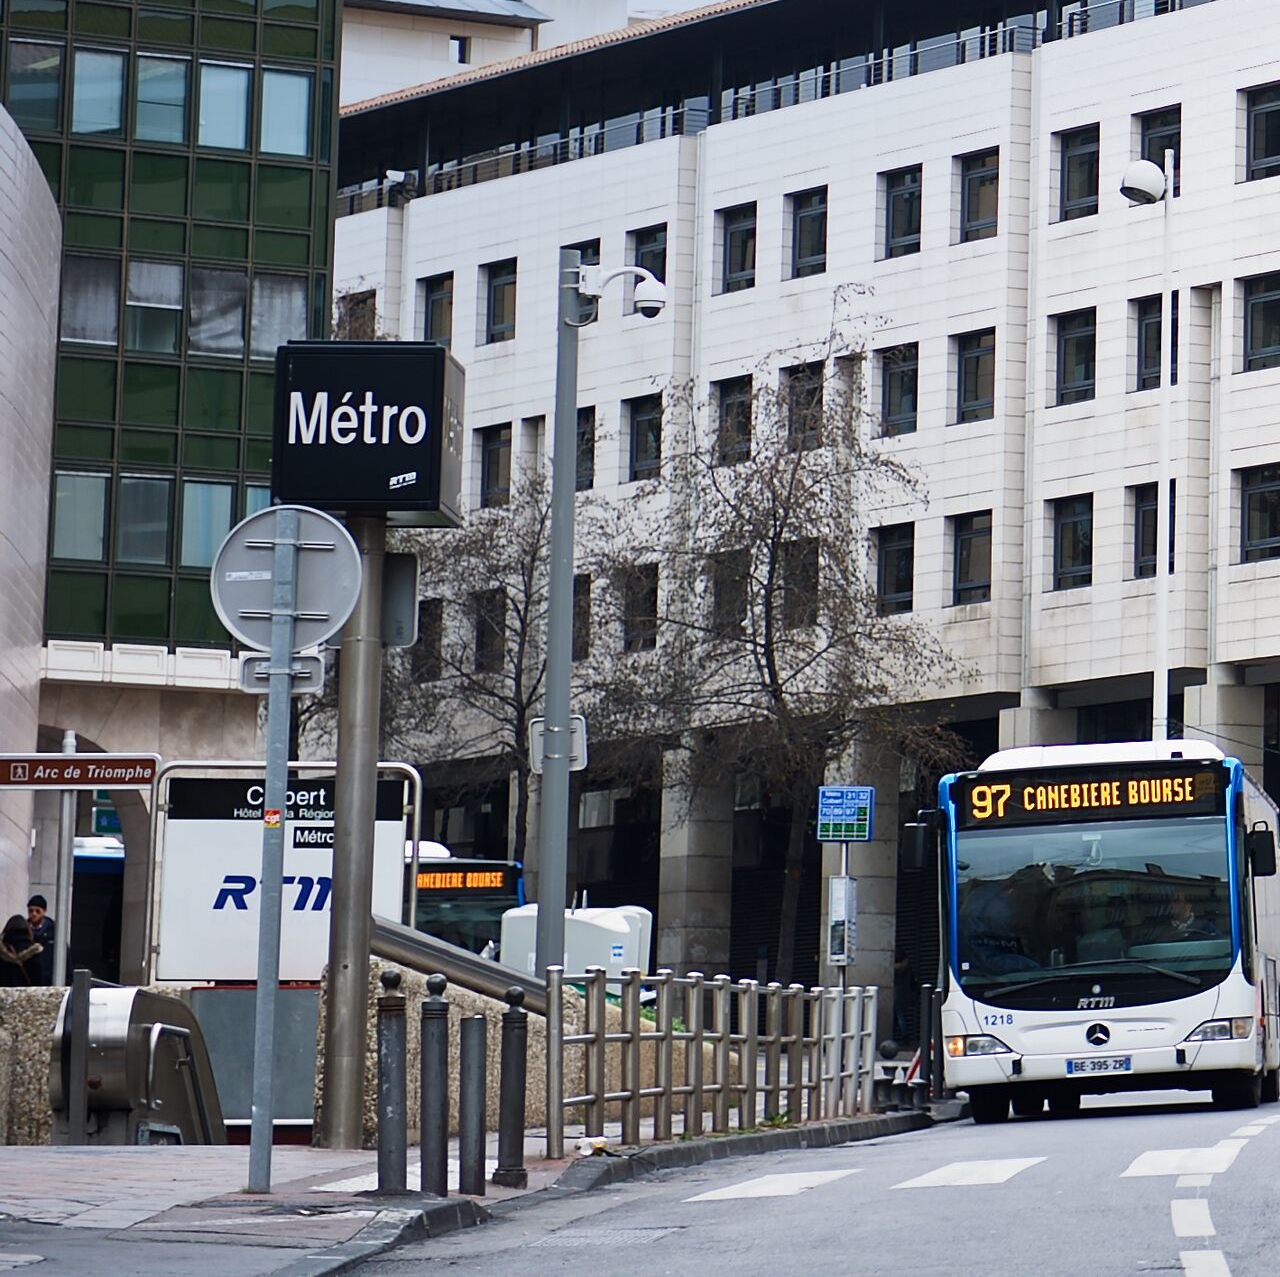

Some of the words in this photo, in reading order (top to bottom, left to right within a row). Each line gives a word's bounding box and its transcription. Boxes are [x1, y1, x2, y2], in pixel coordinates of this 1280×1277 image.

[287, 391, 427, 445] Métro
[34, 765, 59, 778] Arc
[64, 765, 81, 778] de
[87, 765, 152, 781] Triomphe
[971, 784, 1011, 819] 97
[1023, 782, 1121, 811] CANEBIERE
[1128, 777, 1194, 805] BOURSE
[233, 808, 262, 819] Hôtel
[466, 871, 504, 888] BOURSE
[1076, 996, 1116, 1009] RTM
[983, 1014, 1014, 1026] 1218
